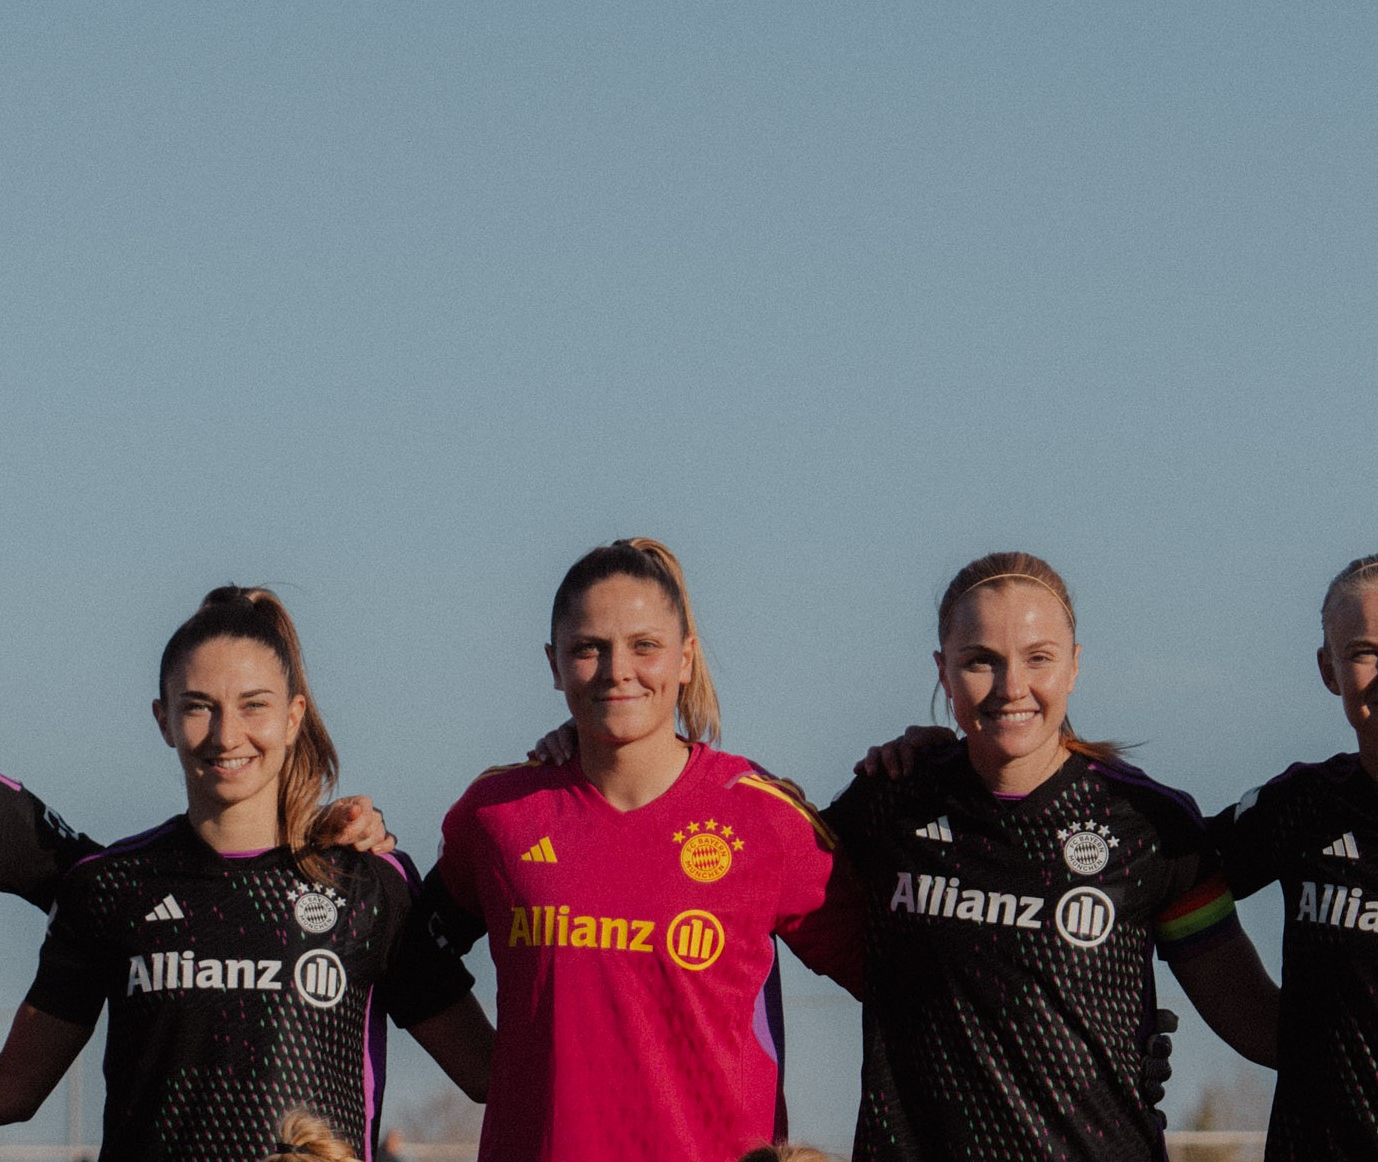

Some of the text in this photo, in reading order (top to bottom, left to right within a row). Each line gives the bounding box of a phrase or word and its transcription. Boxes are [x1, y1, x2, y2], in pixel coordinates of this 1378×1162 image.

[698, 837, 727, 857] BAYERN
[890, 872, 1045, 929] Allianz
[508, 904, 656, 953] Allianz
[126, 949, 283, 997] Allianz
